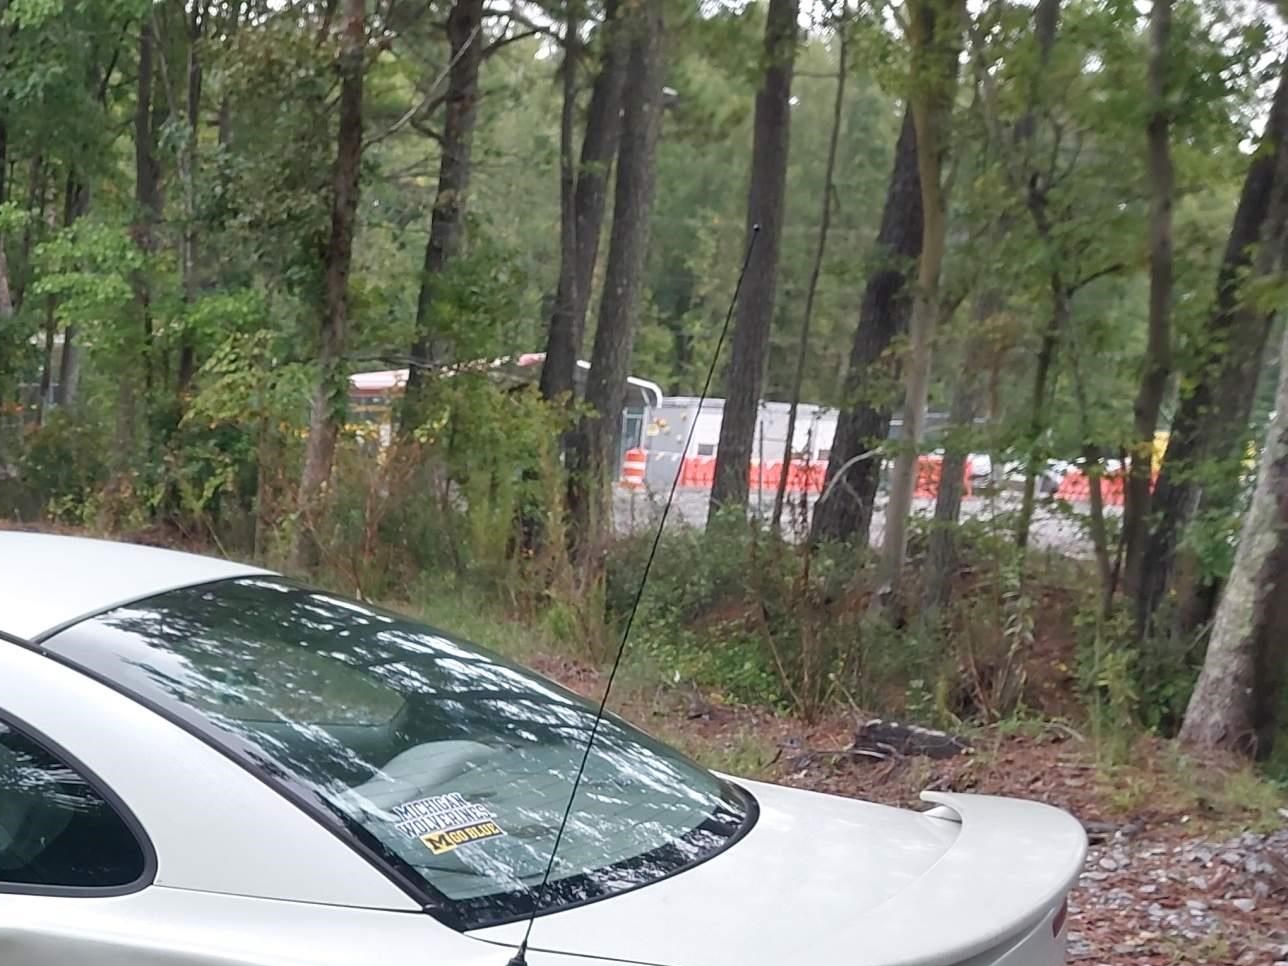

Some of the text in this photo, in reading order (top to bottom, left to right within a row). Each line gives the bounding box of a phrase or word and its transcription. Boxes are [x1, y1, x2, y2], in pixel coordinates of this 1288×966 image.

[393, 792, 469, 821] MICHIGAN
[396, 804, 493, 838] WOLVERINES
[423, 822, 499, 851] M GO BLUE
